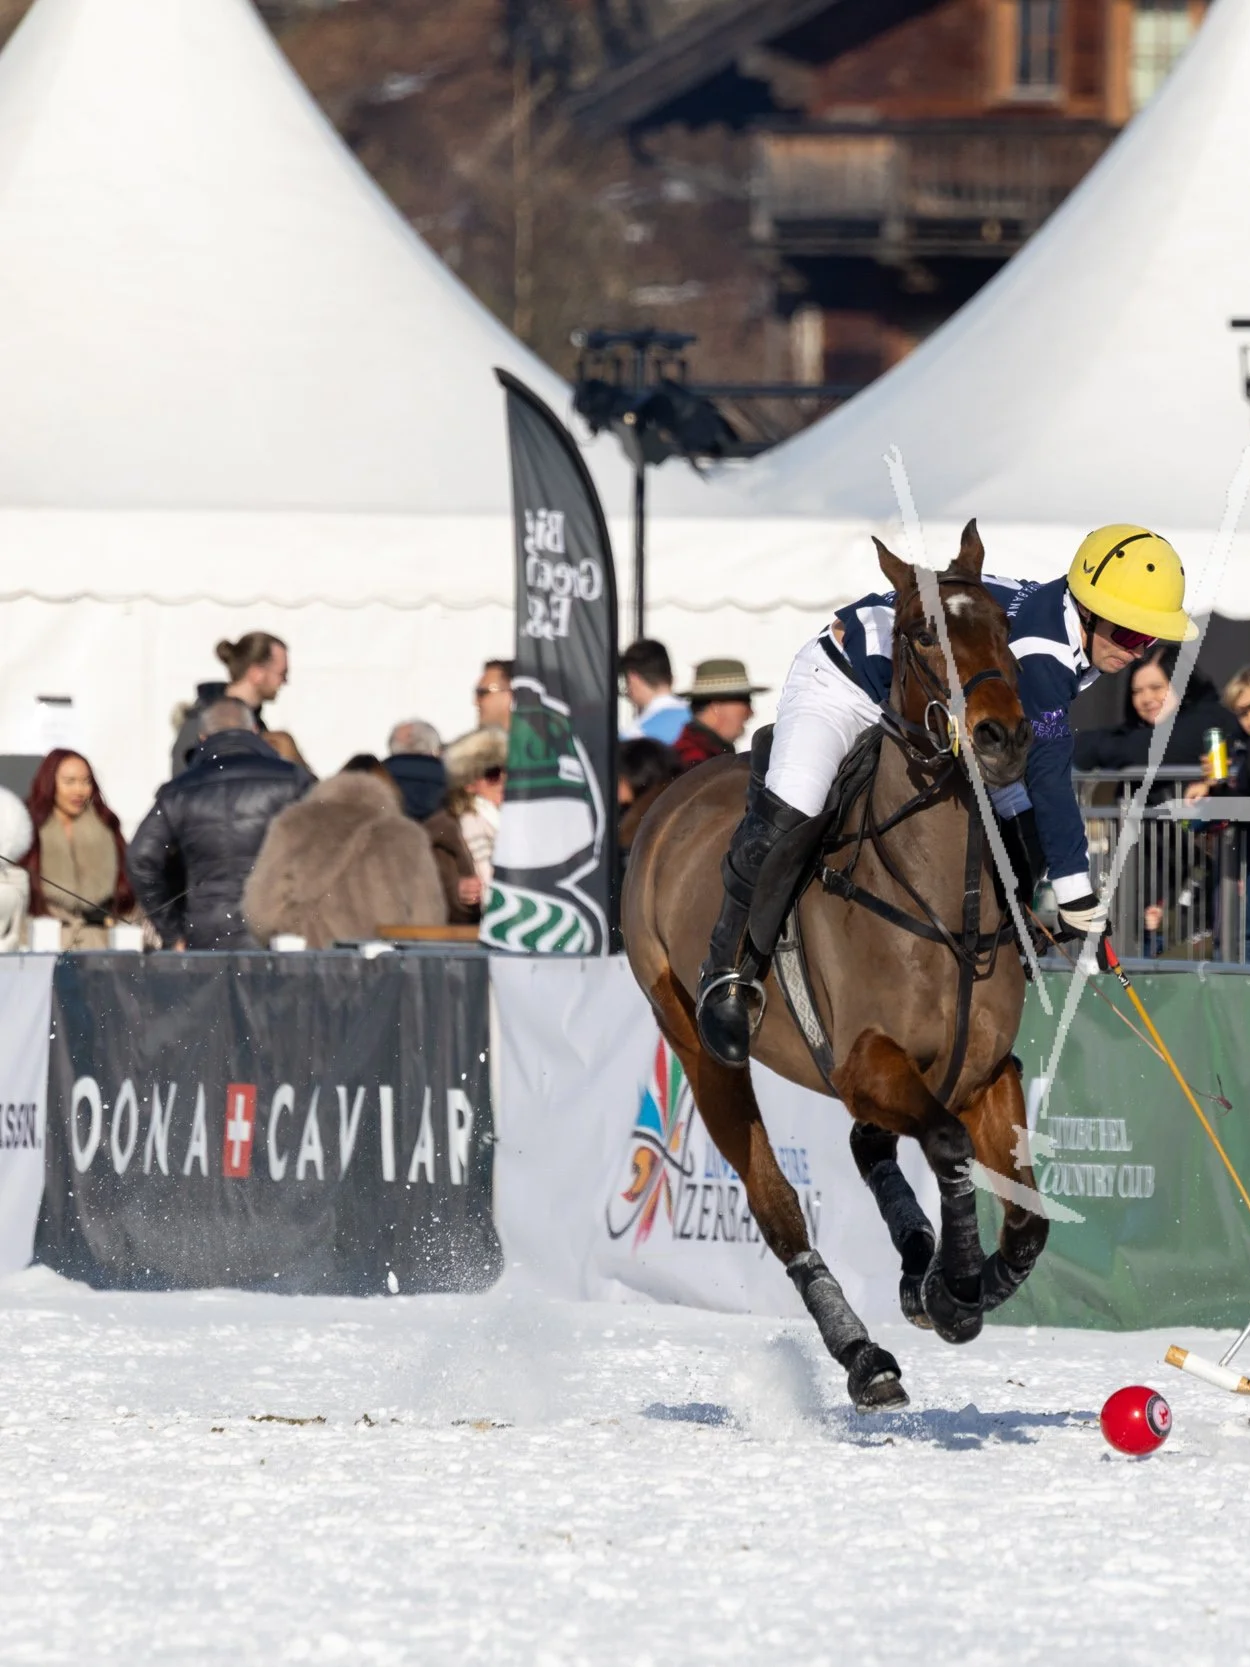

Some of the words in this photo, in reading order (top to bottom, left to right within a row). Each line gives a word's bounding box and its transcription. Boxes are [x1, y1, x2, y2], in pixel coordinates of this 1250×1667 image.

[1006, 591, 1030, 617] BANK
[71, 1075, 209, 1178] OONA
[267, 1082, 475, 1186] CAVIAR
